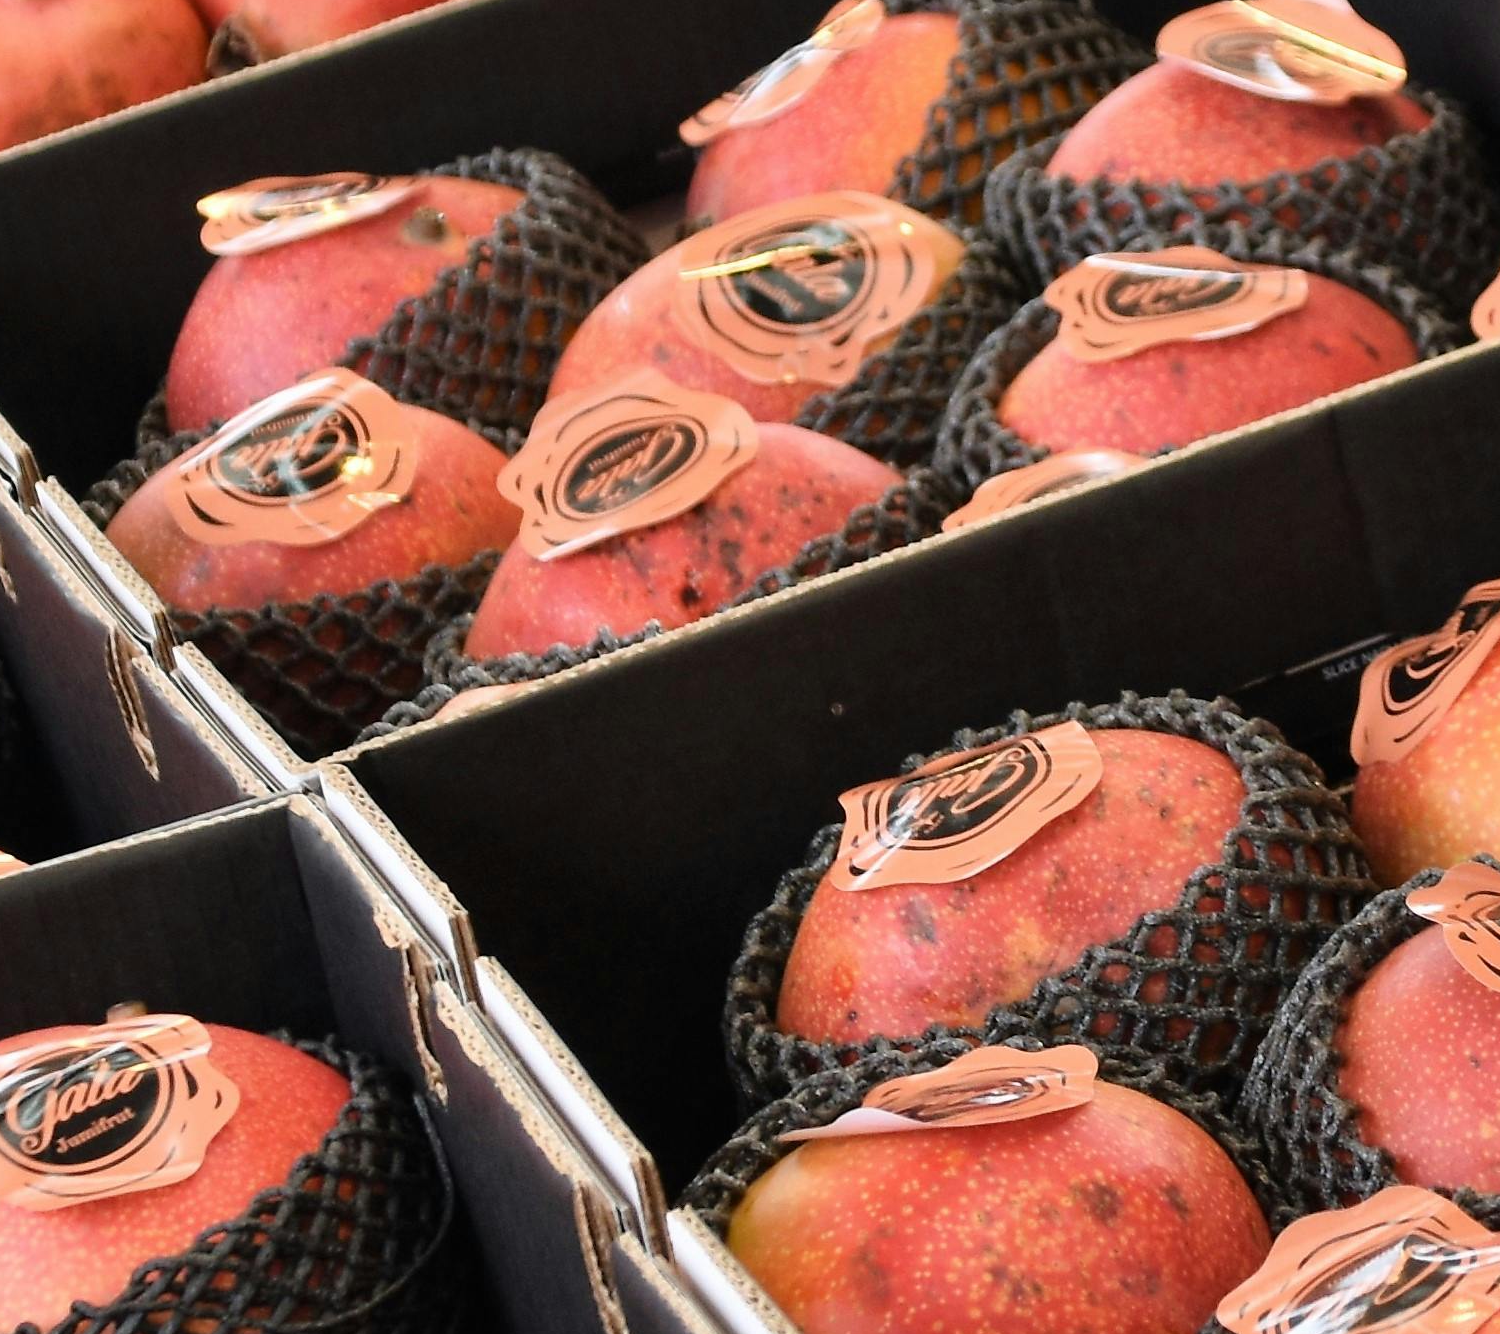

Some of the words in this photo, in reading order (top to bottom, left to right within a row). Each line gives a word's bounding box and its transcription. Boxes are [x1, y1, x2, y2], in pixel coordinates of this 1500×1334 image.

[575, 423, 684, 501] Gala
[5, 1055, 144, 1156] Gala
[56, 1107, 137, 1155] Jumifrut
